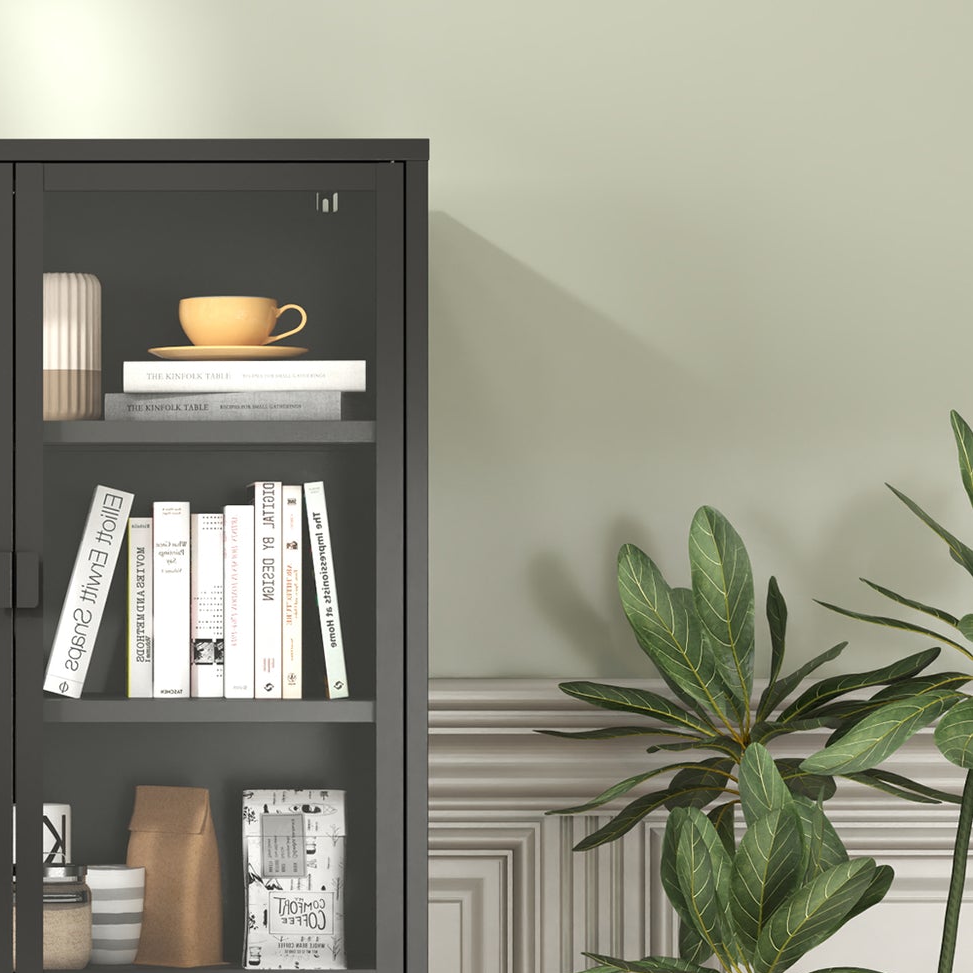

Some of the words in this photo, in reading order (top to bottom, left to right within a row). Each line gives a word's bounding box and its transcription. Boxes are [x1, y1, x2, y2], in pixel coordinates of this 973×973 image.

[146, 372, 164, 381] THE
[165, 372, 203, 381] KINFOLK
[206, 372, 231, 381] TABLE
[126, 404, 145, 412] THE
[183, 403, 209, 411] TABLE
